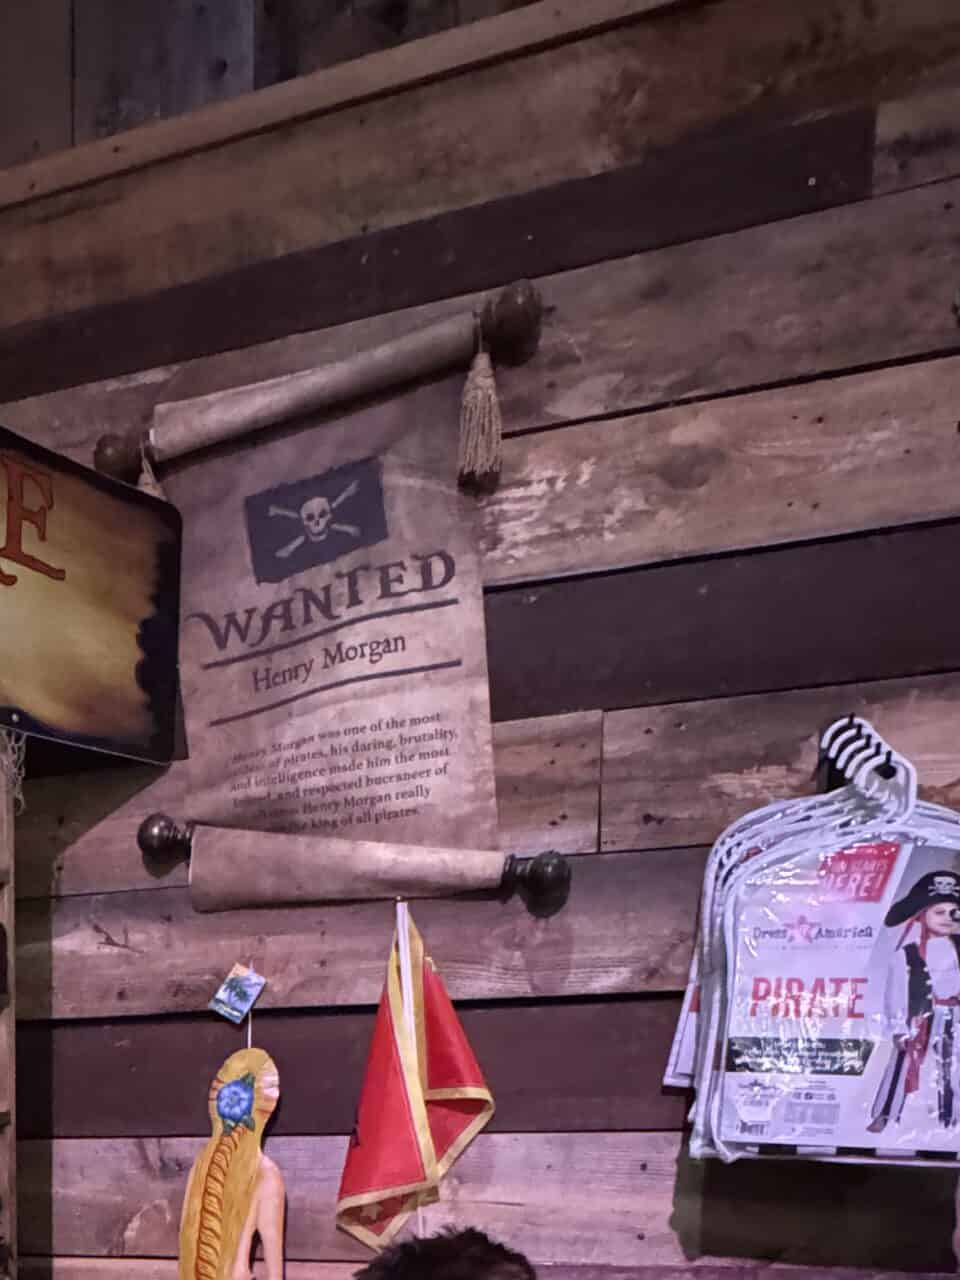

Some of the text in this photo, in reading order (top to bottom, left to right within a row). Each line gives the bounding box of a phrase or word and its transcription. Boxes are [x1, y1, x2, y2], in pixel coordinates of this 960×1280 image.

[186, 549, 456, 651] WANTED
[251, 635, 407, 693] Henry Morgan
[343, 725, 367, 737] one
[369, 718, 383, 731] of
[385, 716, 407, 730] the
[408, 712, 440, 727] most
[330, 743, 349, 756] his
[398, 728, 459, 746] brutality,
[329, 759, 365, 776] made
[366, 755, 392, 769] him
[394, 751, 416, 765] the
[418, 746, 450, 761] most
[302, 778, 363, 798] respected
[365, 767, 433, 787] buccaneer
[435, 761, 450, 776] of
[302, 800, 341, 816] Henry
[343, 793, 392, 810] Morgan
[395, 783, 432, 801] really
[340, 814, 354, 826] of
[356, 809, 372, 825] all
[749, 975, 869, 1019] PIRATE
